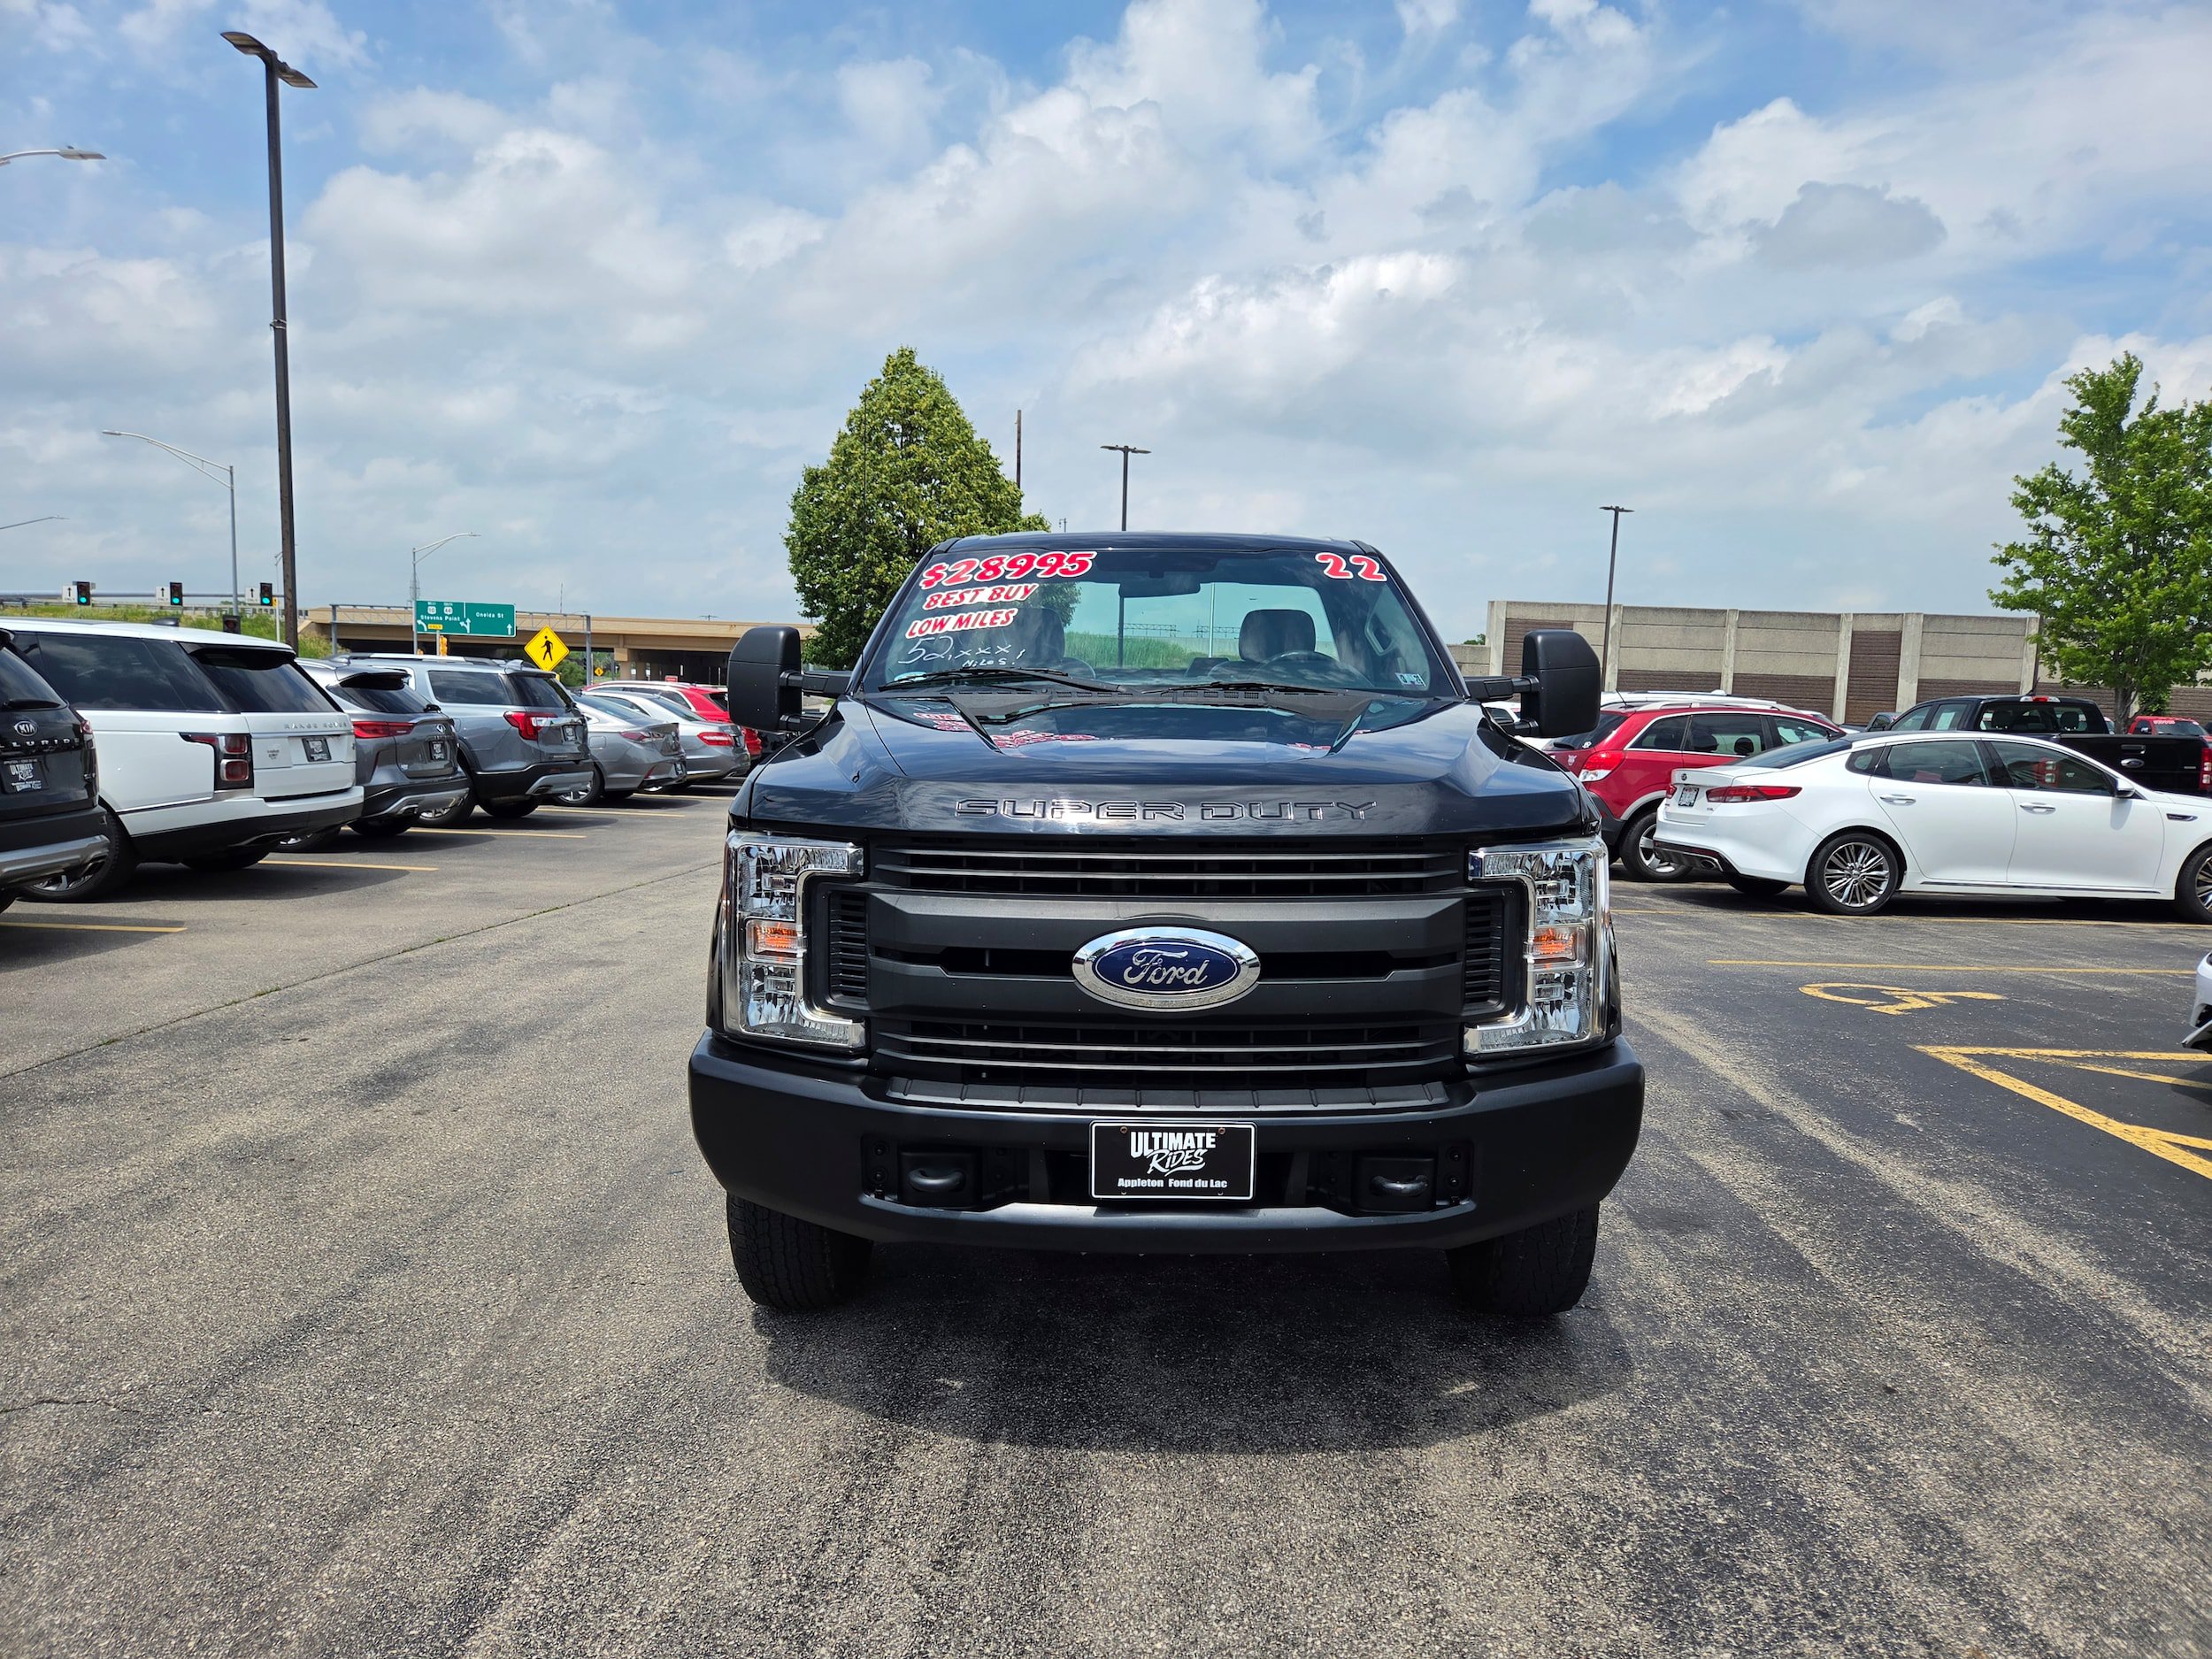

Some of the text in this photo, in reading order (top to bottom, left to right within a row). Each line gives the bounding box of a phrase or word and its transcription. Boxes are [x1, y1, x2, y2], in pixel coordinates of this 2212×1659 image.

[919, 551, 1097, 589] $28995
[1315, 552, 1387, 581] 22
[923, 583, 1039, 610] BEST BUY
[906, 608, 1018, 639] LOW MILES
[19, 724, 36, 733] KIA
[955, 799, 1378, 821] SUPER DUTY
[1123, 949, 1210, 985] Ford
[1130, 1131, 1217, 1159] ULTIMATE
[1118, 1178, 1228, 1189] Appleton Fond du Lac
